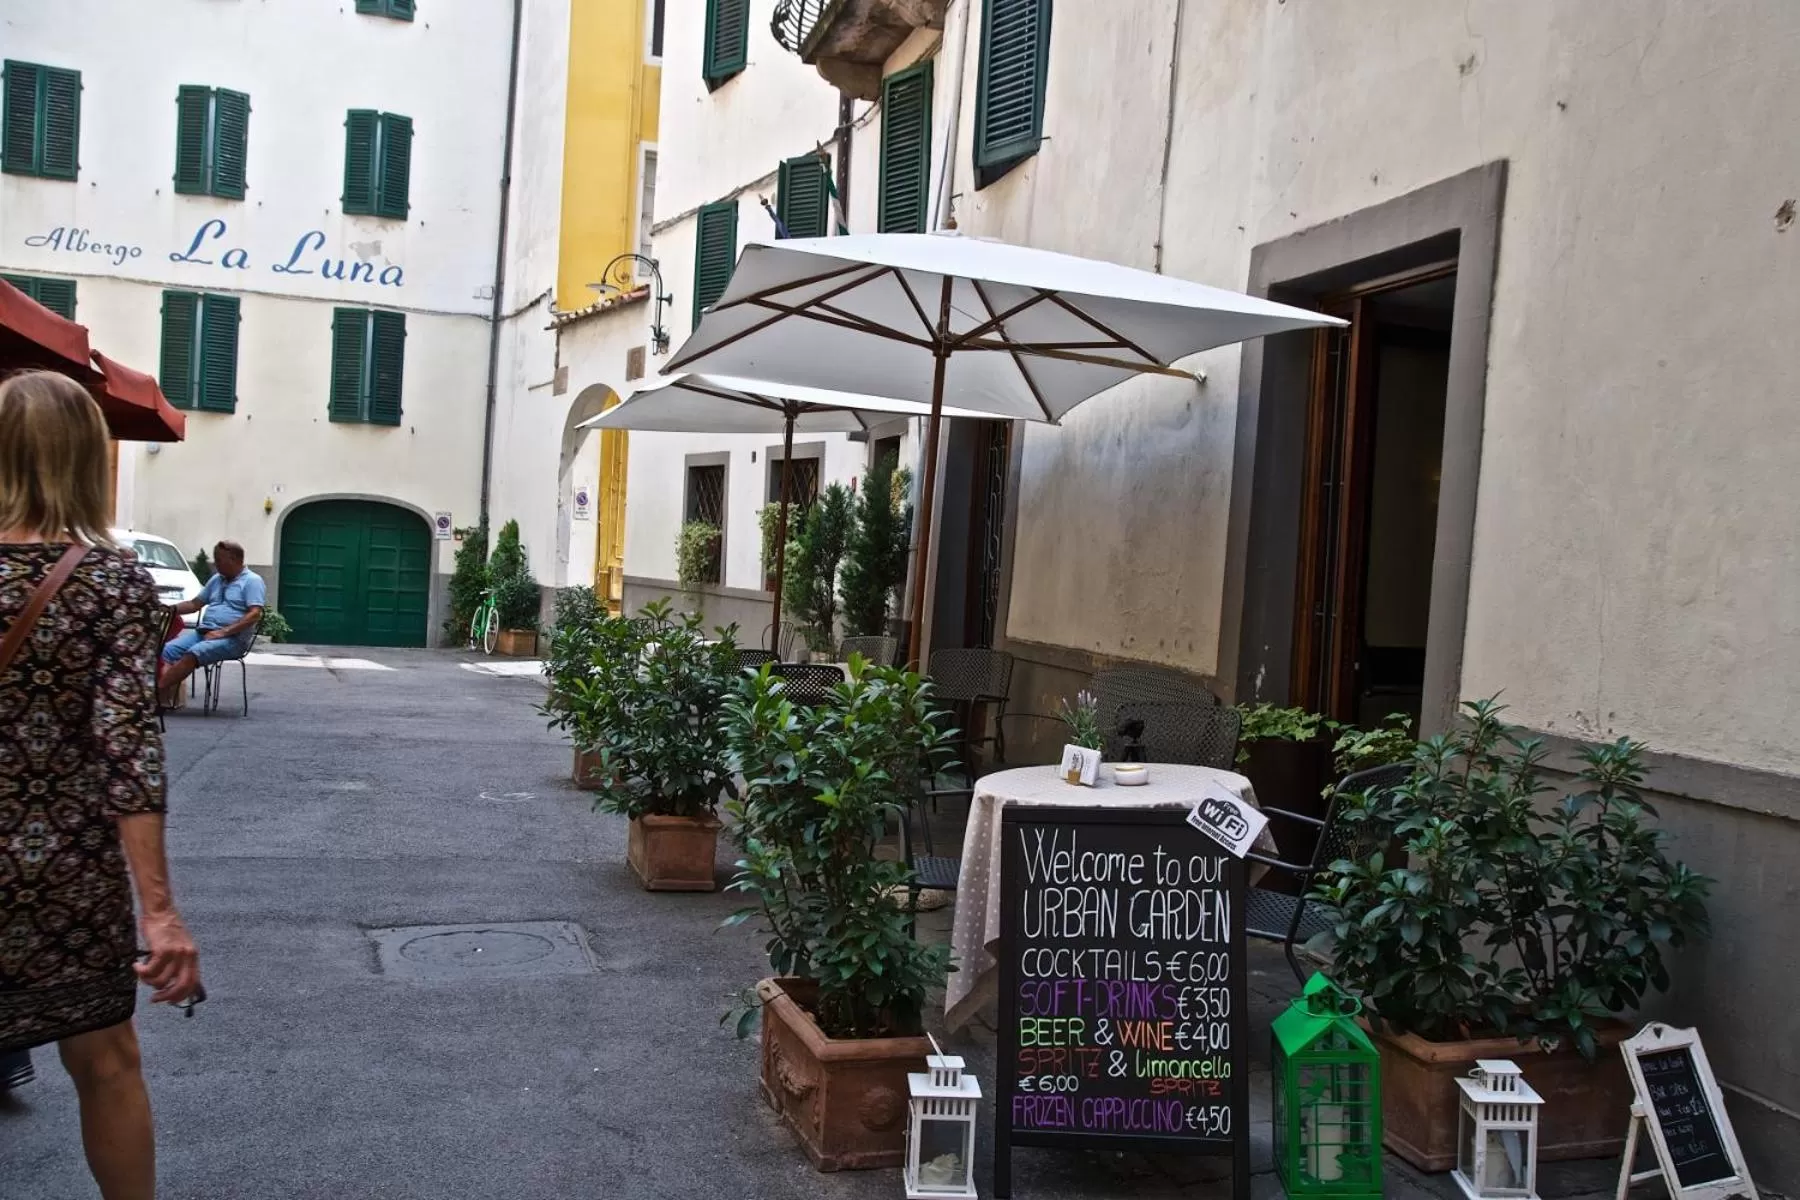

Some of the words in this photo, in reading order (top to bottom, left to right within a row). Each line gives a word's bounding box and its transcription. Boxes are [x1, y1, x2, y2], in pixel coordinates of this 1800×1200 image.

[24, 226, 143, 266] Albergo
[169, 218, 250, 270] La
[272, 230, 405, 288] Luna
[1020, 828, 1145, 885] Welcome
[1153, 844, 1181, 886] to
[1188, 855, 1229, 883] our
[1023, 886, 1118, 938] URBAN
[1129, 889, 1230, 944] GARDEN
[1021, 948, 1162, 982] COCKTAILS
[1019, 979, 1177, 1020] SOFT-DRINKS
[1020, 1017, 1085, 1047] BEER
[1094, 1018, 1114, 1046] &
[1117, 1020, 1175, 1051] WINE
[1018, 1048, 1102, 1079] SPRITZ
[1108, 1050, 1128, 1078] &
[1150, 1079, 1221, 1096] SPRITZ
[1012, 1095, 1075, 1127] FROZEN
[1082, 1097, 1183, 1132] CAPPUCCINO
